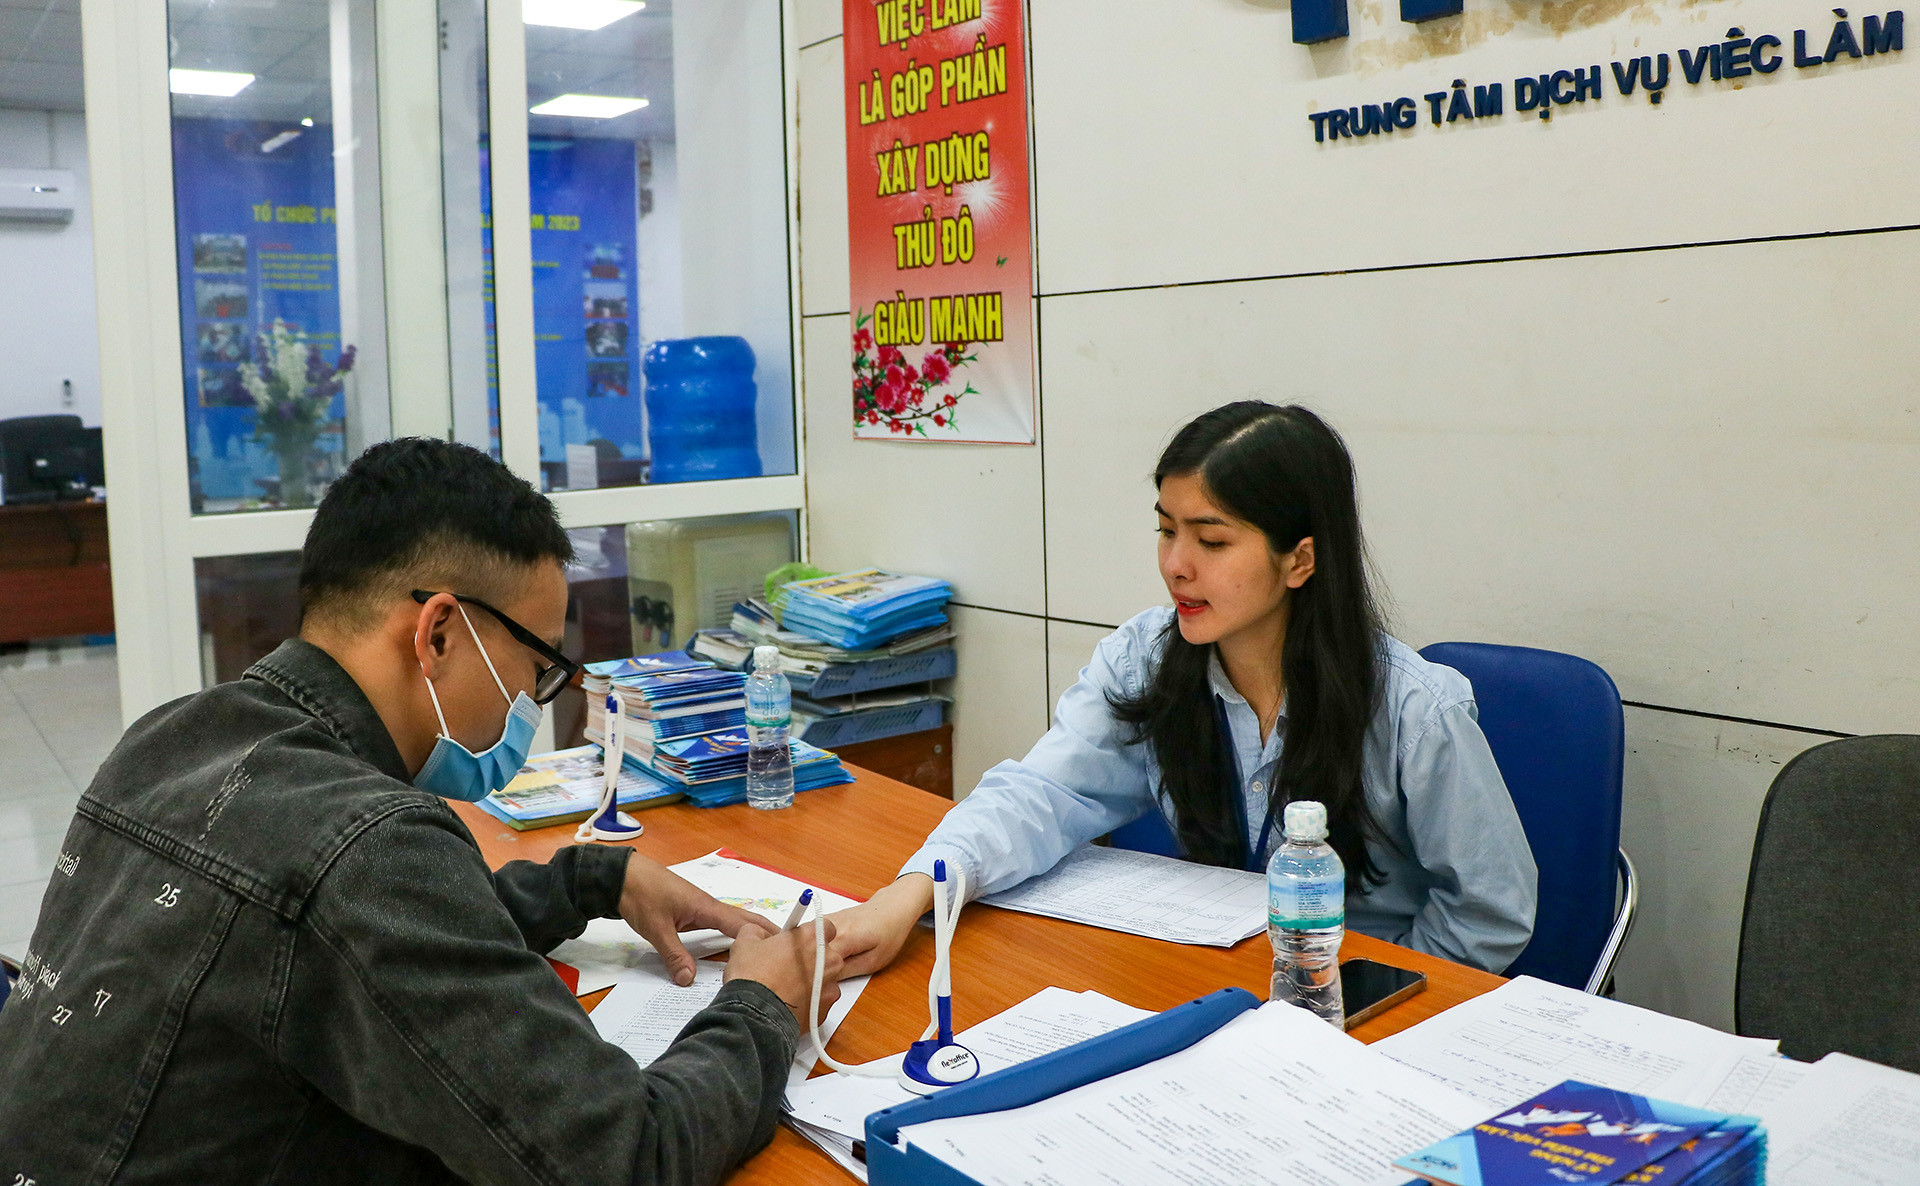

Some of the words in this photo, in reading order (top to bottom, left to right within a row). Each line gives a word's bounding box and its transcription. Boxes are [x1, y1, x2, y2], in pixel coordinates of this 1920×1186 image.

[859, 69, 886, 127] LÀ
[889, 58, 934, 120] GÓP
[940, 32, 1008, 108] PHẦN
[1309, 97, 1416, 143] TRUNG
[1424, 79, 1503, 125] TÂM
[1515, 65, 1602, 121] DỊCH
[1610, 53, 1670, 104] VỤ
[1793, 8, 1904, 69] LÀM
[876, 135, 919, 198] XÂY
[924, 130, 990, 195] DỰNG
[892, 204, 936, 270] THỦ
[940, 206, 975, 265] ĐÔ
[873, 290, 925, 347] GIÀU
[928, 291, 1004, 352] MẠNH
[153, 883, 181, 907] 25
[51, 1005, 73, 1027] 27
[94, 988, 113, 1018] 17
